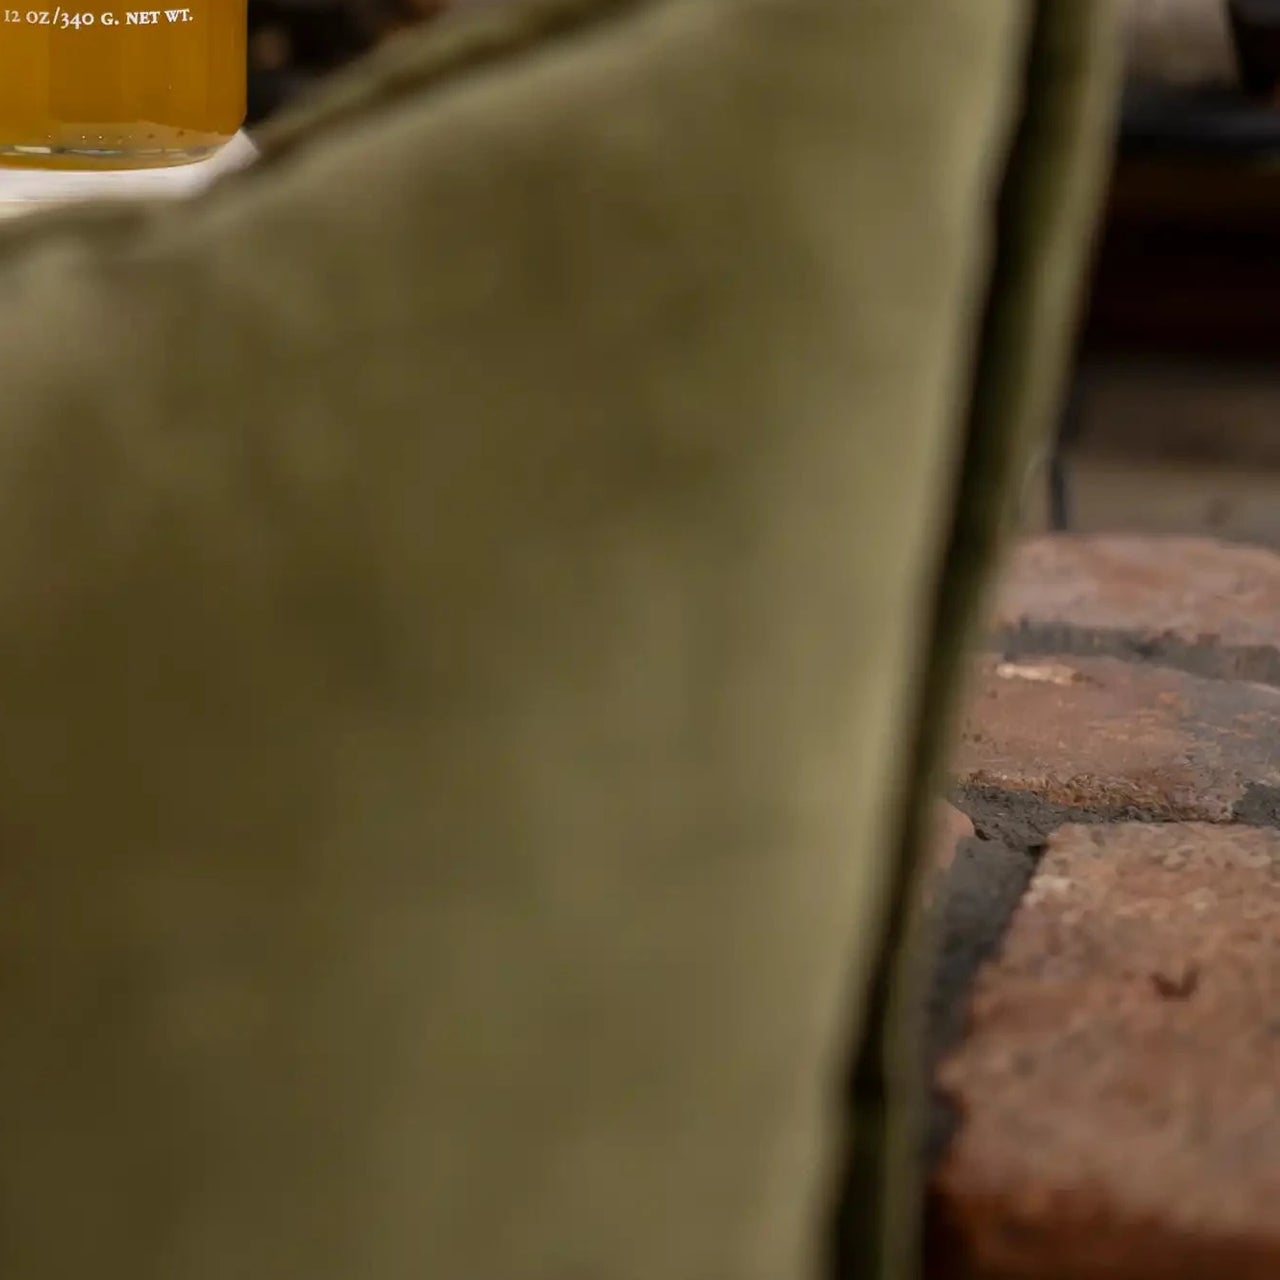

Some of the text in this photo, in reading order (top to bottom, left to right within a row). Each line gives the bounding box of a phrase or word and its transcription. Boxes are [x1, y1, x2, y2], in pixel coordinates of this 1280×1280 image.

[5, 10, 20, 22] 12
[101, 13, 119, 25] G.
[127, 11, 160, 24] NET
[165, 9, 192, 22] WT.
